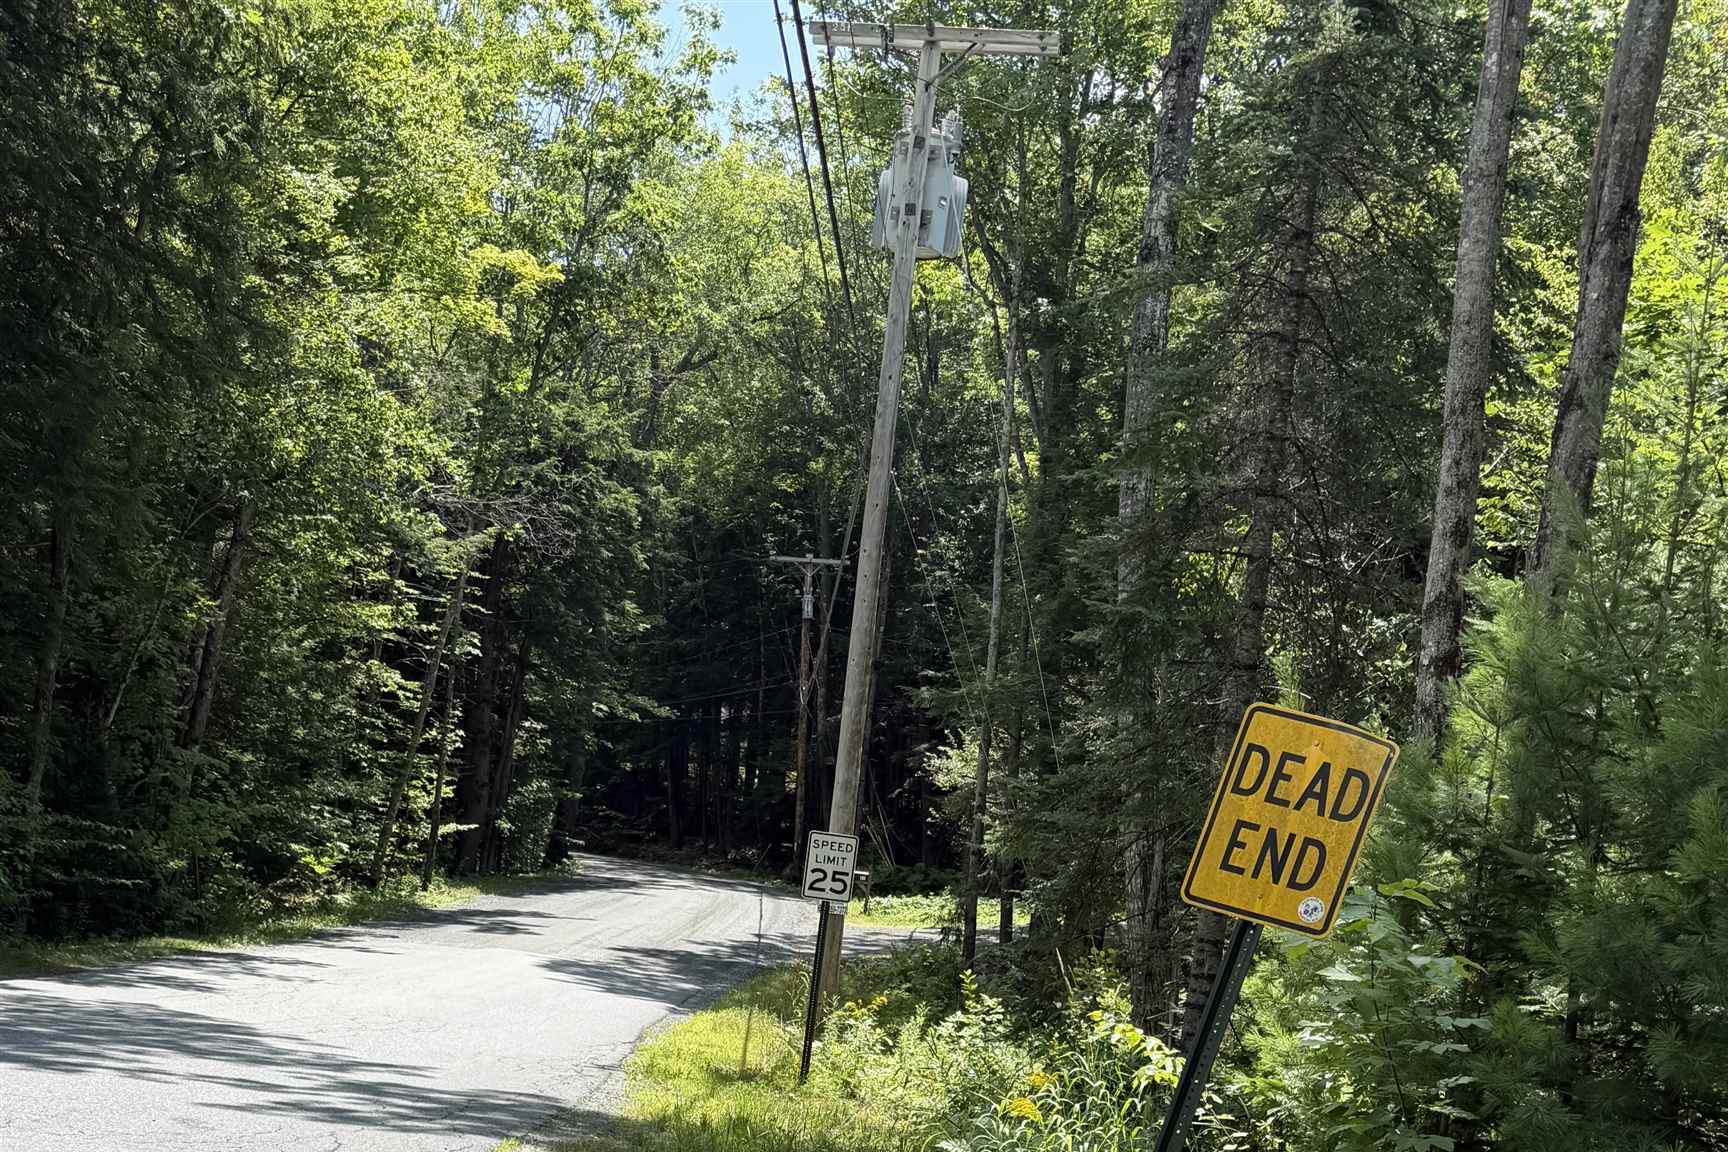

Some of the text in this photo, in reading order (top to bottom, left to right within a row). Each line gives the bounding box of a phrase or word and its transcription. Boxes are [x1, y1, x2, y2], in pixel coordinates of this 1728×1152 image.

[1230, 743, 1371, 822] DEAD
[812, 839, 853, 853] SPEED
[1219, 819, 1327, 891] END
[815, 854, 847, 866] LIMIT
[808, 868, 849, 895] 25
